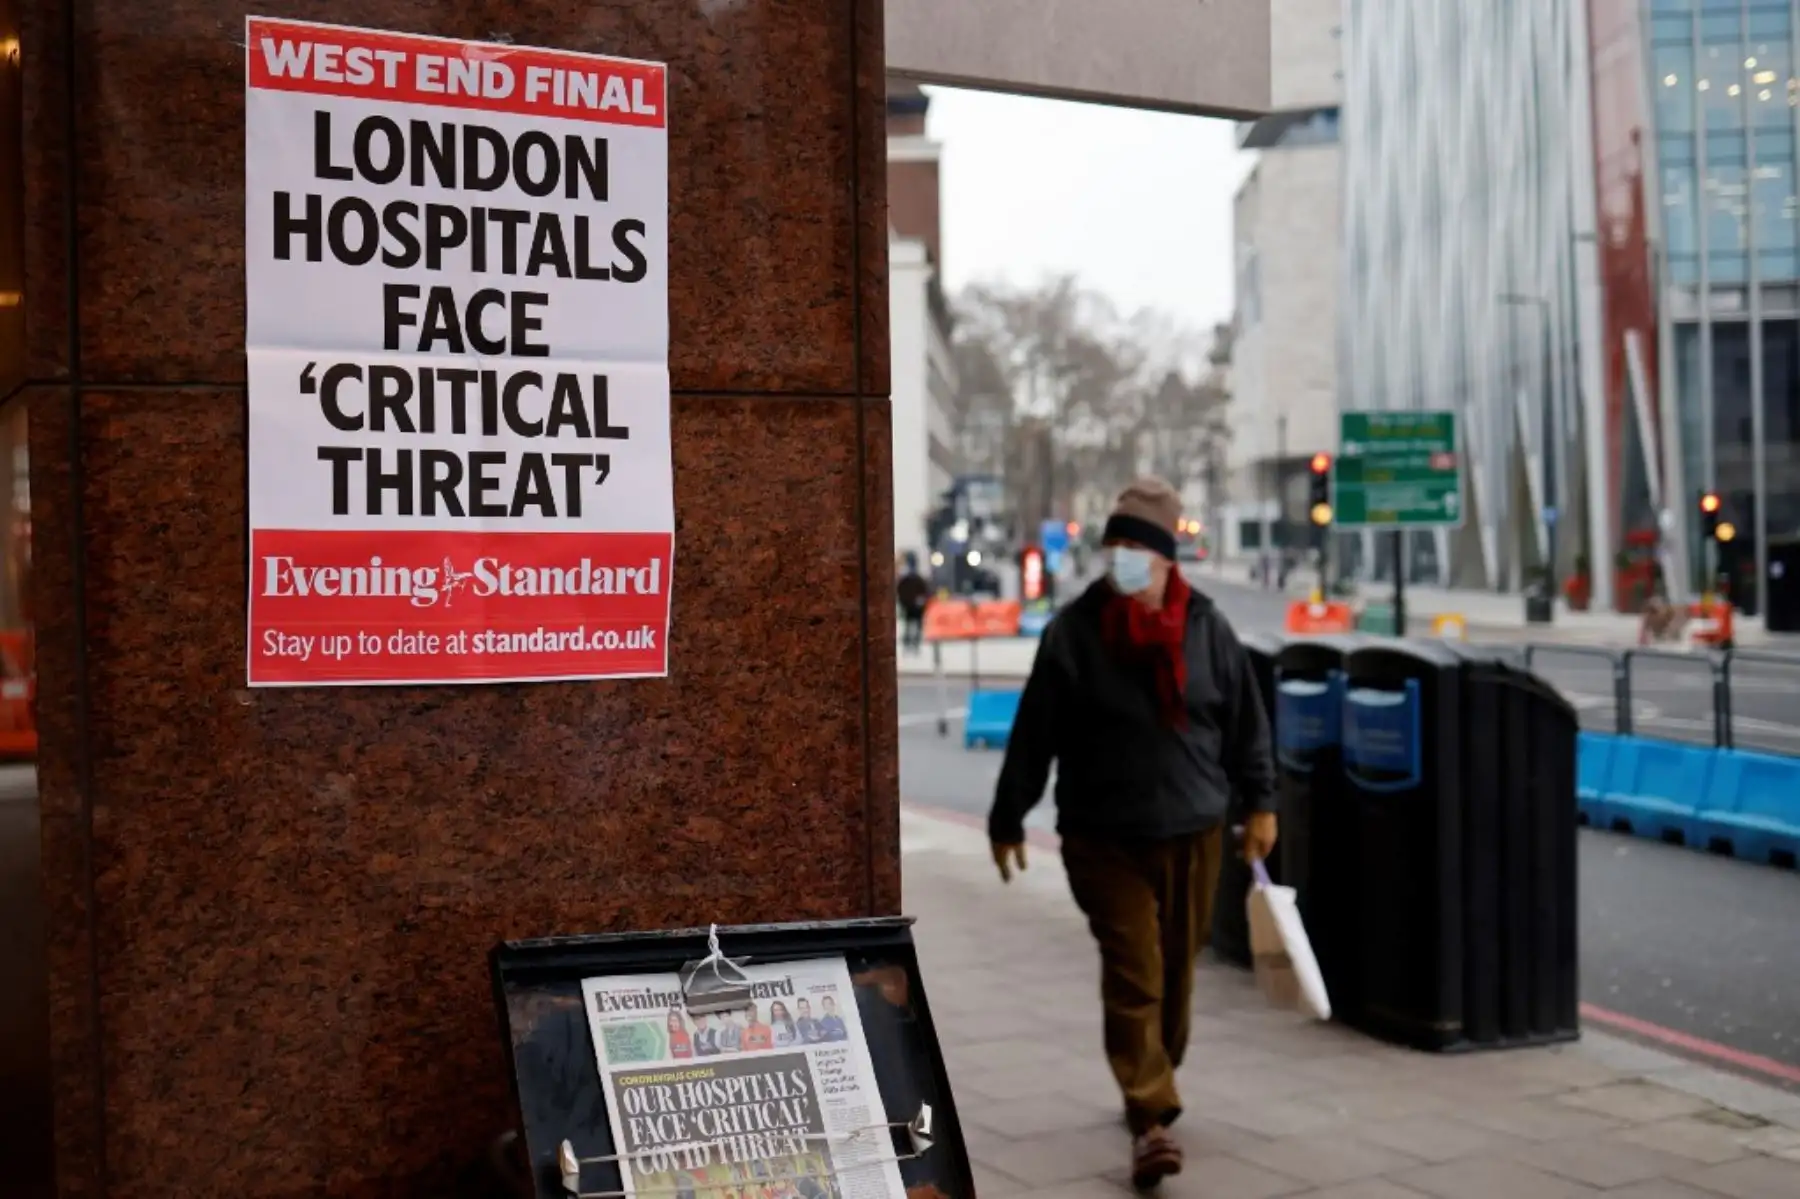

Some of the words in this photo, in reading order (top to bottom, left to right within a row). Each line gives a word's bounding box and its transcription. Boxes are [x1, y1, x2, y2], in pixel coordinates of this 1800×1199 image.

[261, 37, 407, 88] WEST
[415, 54, 515, 99] END
[525, 67, 656, 115] FINAL
[314, 109, 608, 202] LONDON
[273, 191, 647, 283] HOSPITALS
[383, 283, 549, 357] FACE
[261, 556, 439, 607] Evening
[473, 556, 660, 596] Standard
[263, 629, 315, 661] Stay
[320, 633, 352, 660] up
[357, 631, 381, 655] to
[387, 629, 440, 655] date
[445, 630, 468, 655] at
[472, 625, 655, 653] standard.co.uk
[595, 987, 682, 1012] Evening
[619, 1072, 684, 1086] CORONAVIRUS
[686, 1068, 715, 1079] CRISIS
[623, 1086, 676, 1115] OUR
[676, 1070, 807, 1109] HOSPITALS
[628, 1113, 691, 1145] FACE
[636, 1143, 710, 1176] COVID
